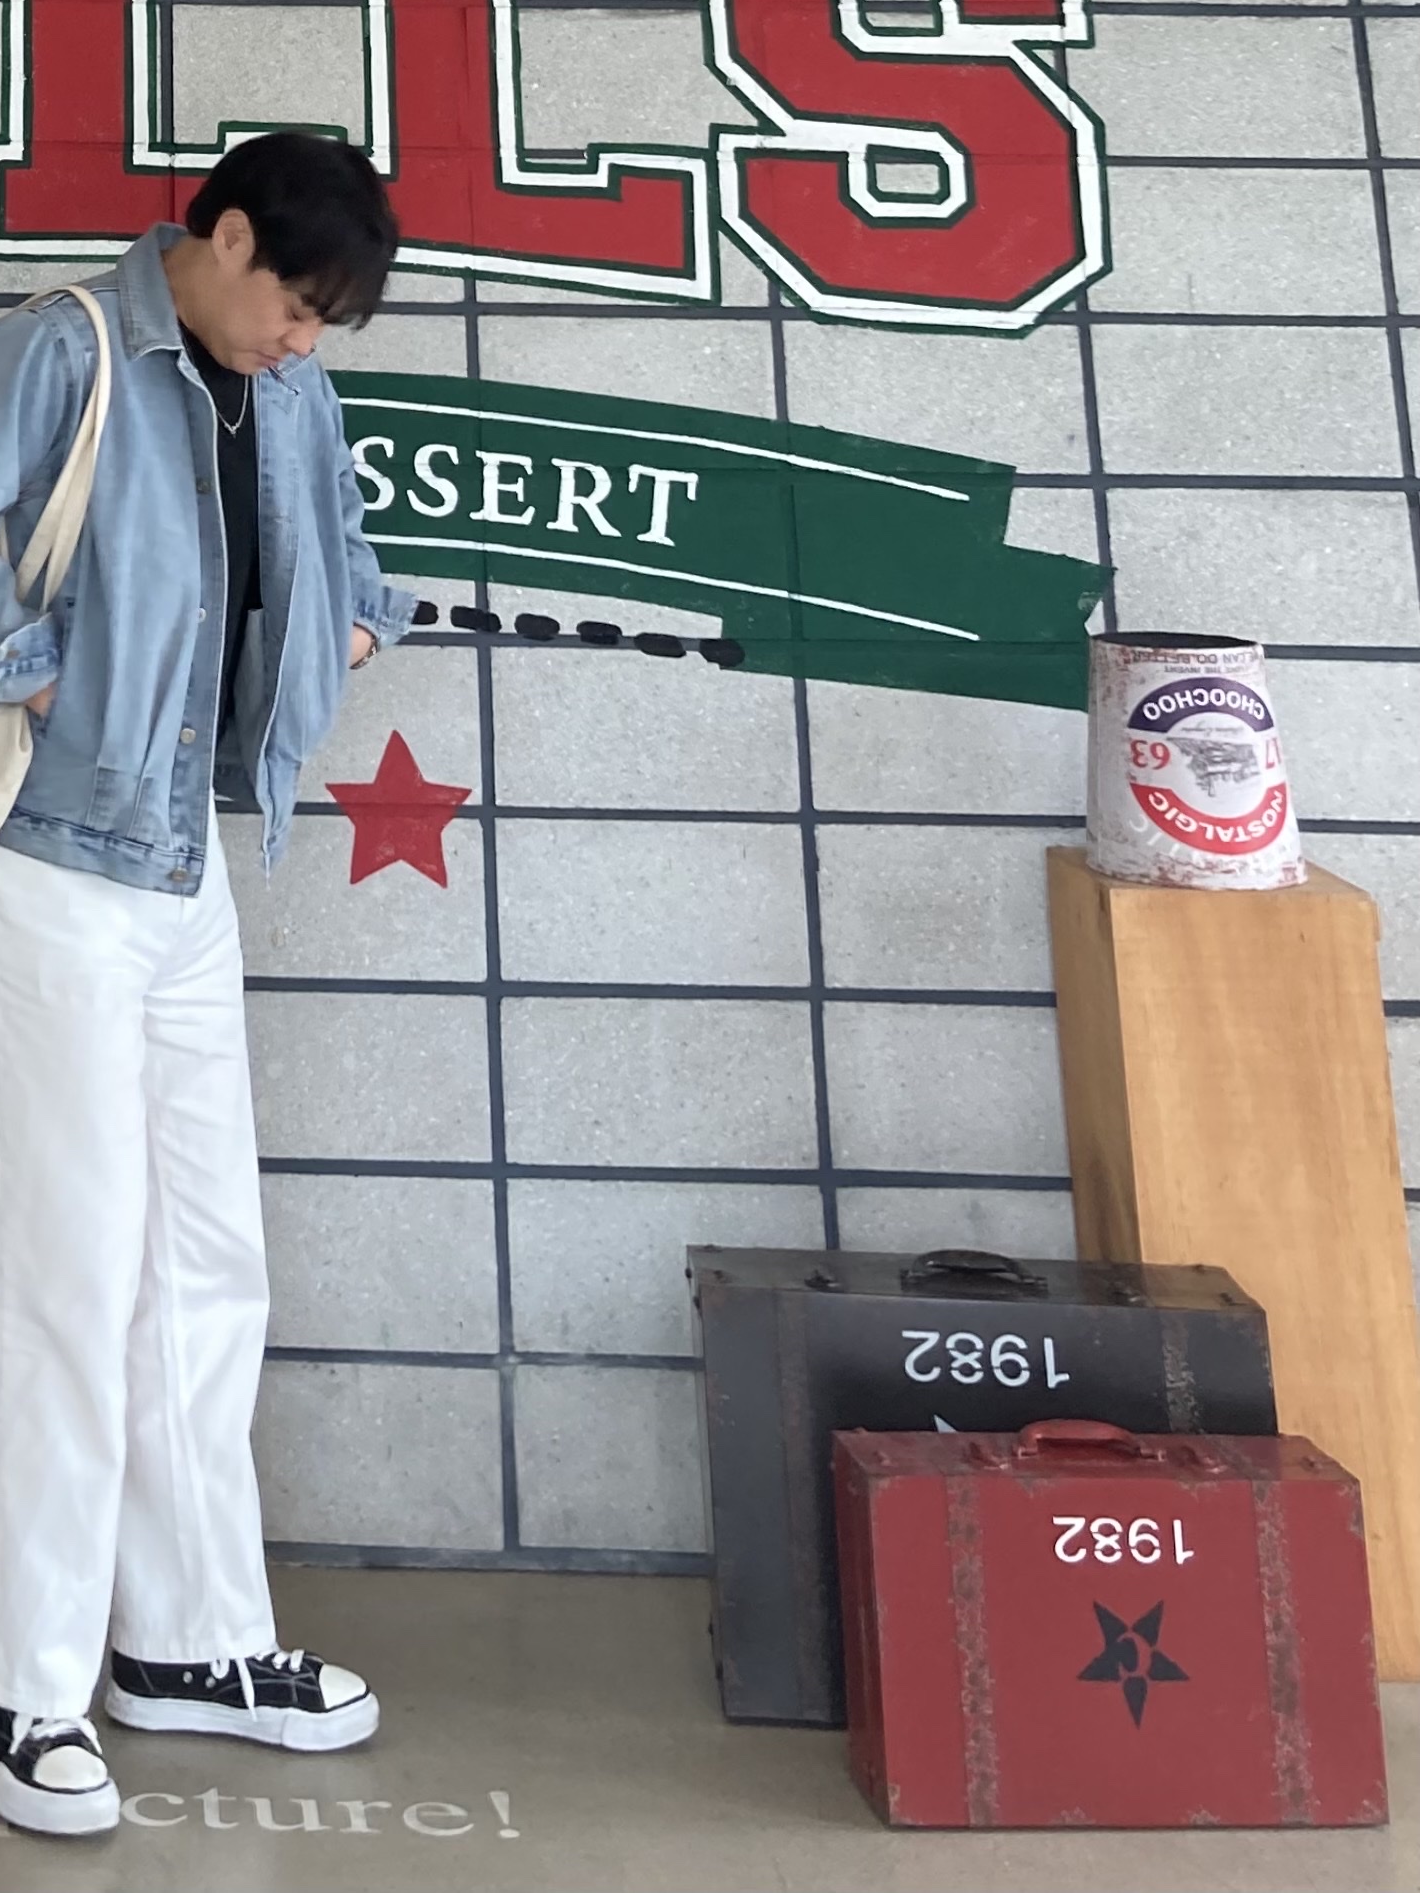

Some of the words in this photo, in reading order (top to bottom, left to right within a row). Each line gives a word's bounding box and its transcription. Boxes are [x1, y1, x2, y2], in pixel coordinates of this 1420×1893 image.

[350, 435, 699, 547] SSERT
[1142, 688, 1265, 721] CHOOCHOO
[1130, 739, 1171, 770] 63
[1148, 790, 1285, 843] NOSTALGIC
[901, 1329, 1070, 1389] 1982
[1052, 1515, 1195, 1565] 1982
